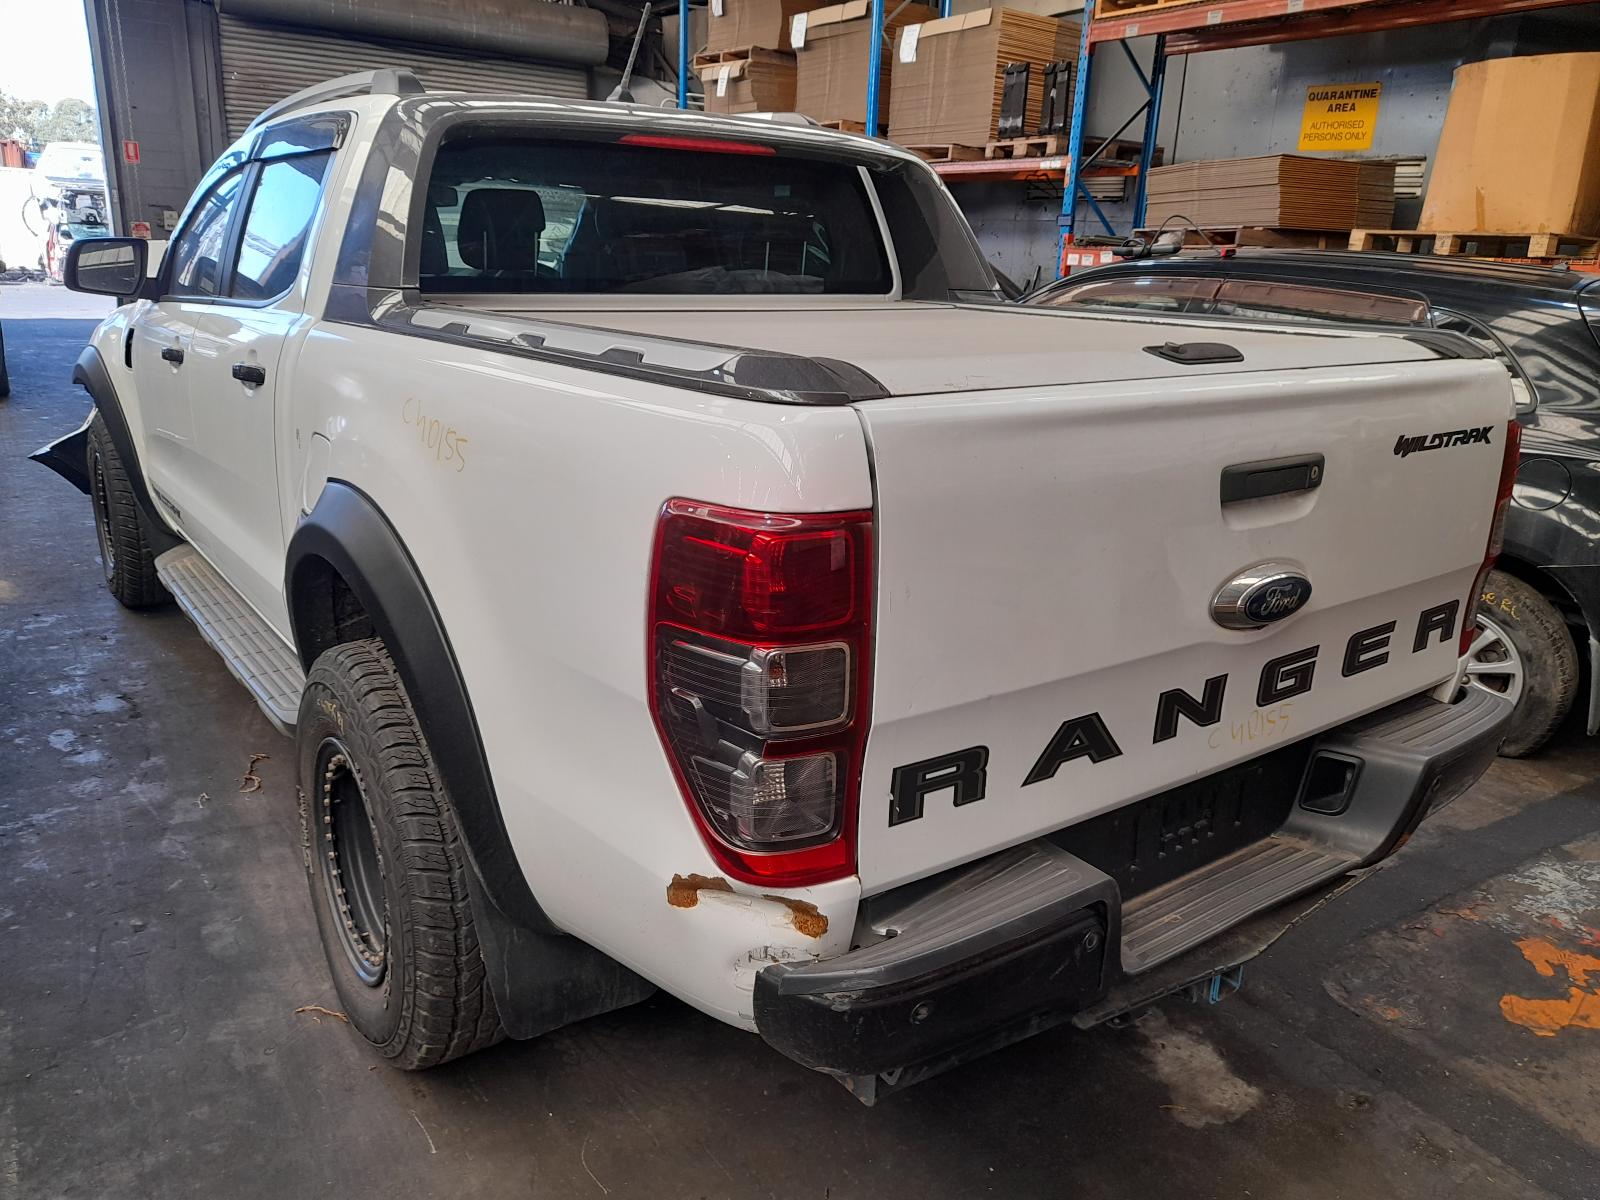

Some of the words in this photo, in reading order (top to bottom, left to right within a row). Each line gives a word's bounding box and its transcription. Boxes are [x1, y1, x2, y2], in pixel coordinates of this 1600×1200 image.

[1308, 88, 1378, 101] QUARANTINE
[1327, 103, 1356, 113] AREA
[1310, 120, 1365, 130] AUTHORISED
[1303, 132, 1342, 141] PERSONS
[1345, 131, 1367, 140] ONLY
[1393, 425, 1495, 458] WILDTRAK
[1261, 584, 1301, 616] Ford
[888, 600, 1459, 827] RANGER
